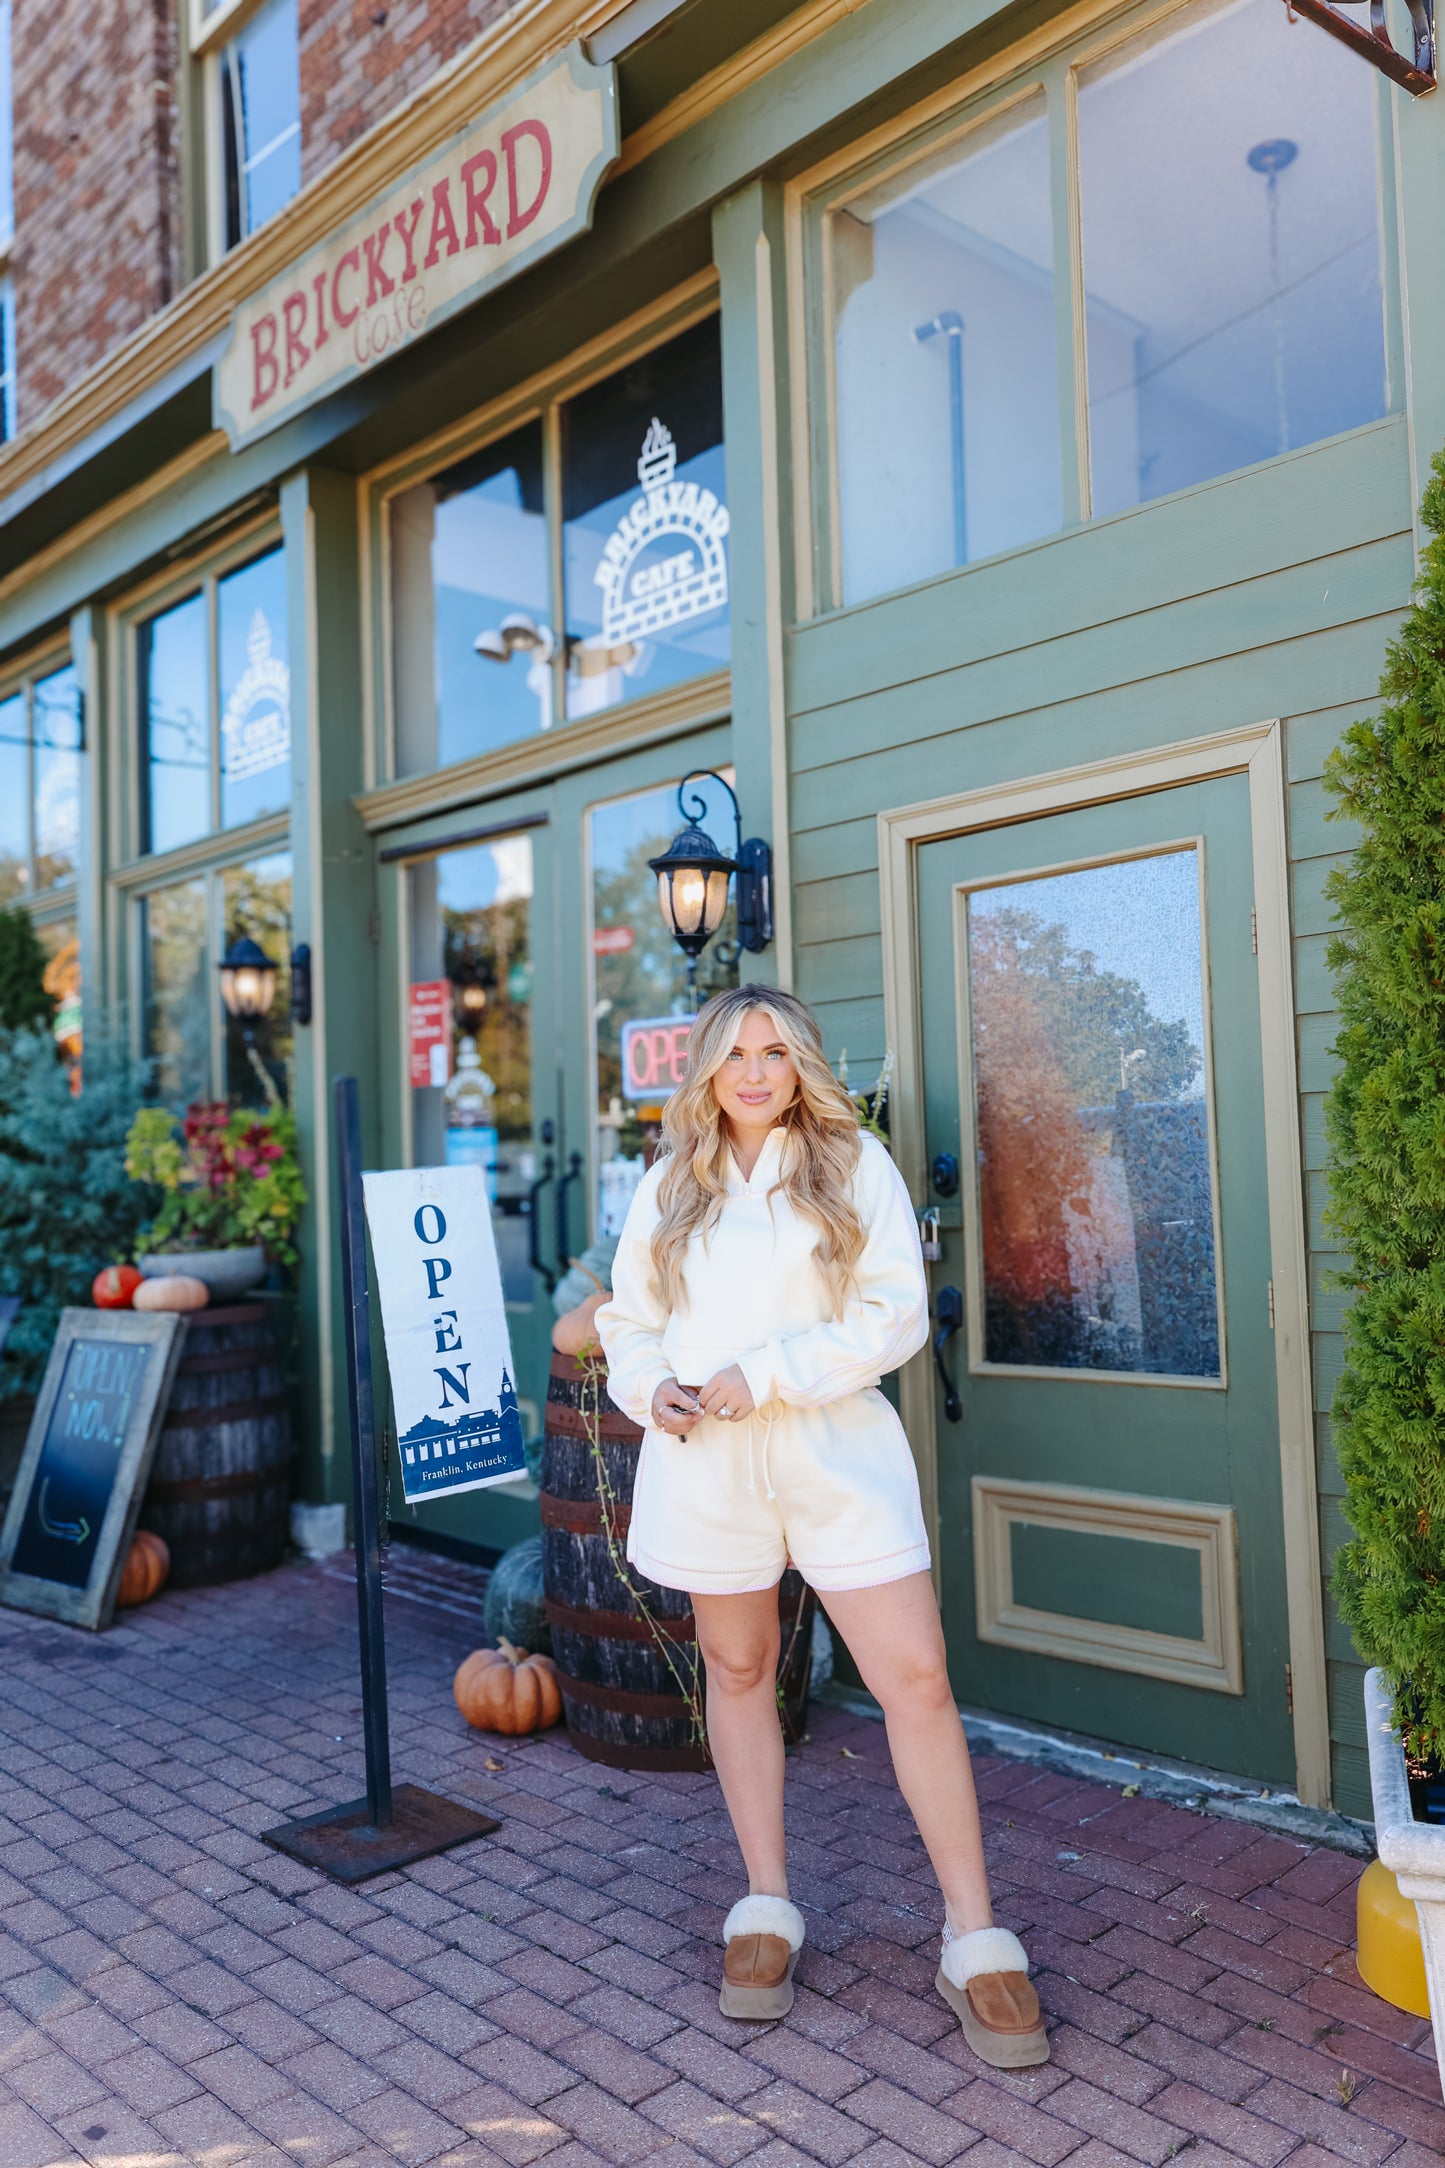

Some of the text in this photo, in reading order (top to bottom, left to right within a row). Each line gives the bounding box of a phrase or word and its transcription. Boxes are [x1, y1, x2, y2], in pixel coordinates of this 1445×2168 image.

[250, 118, 553, 412] BRICKYARD
[593, 481, 730, 587] BRICKYARD
[631, 549, 695, 598] CAFE
[629, 1026, 691, 1086] OPE
[413, 1203, 472, 1411] OPEN
[71, 1348, 133, 1395] OPEN
[465, 1454, 508, 1472] Kentucky
